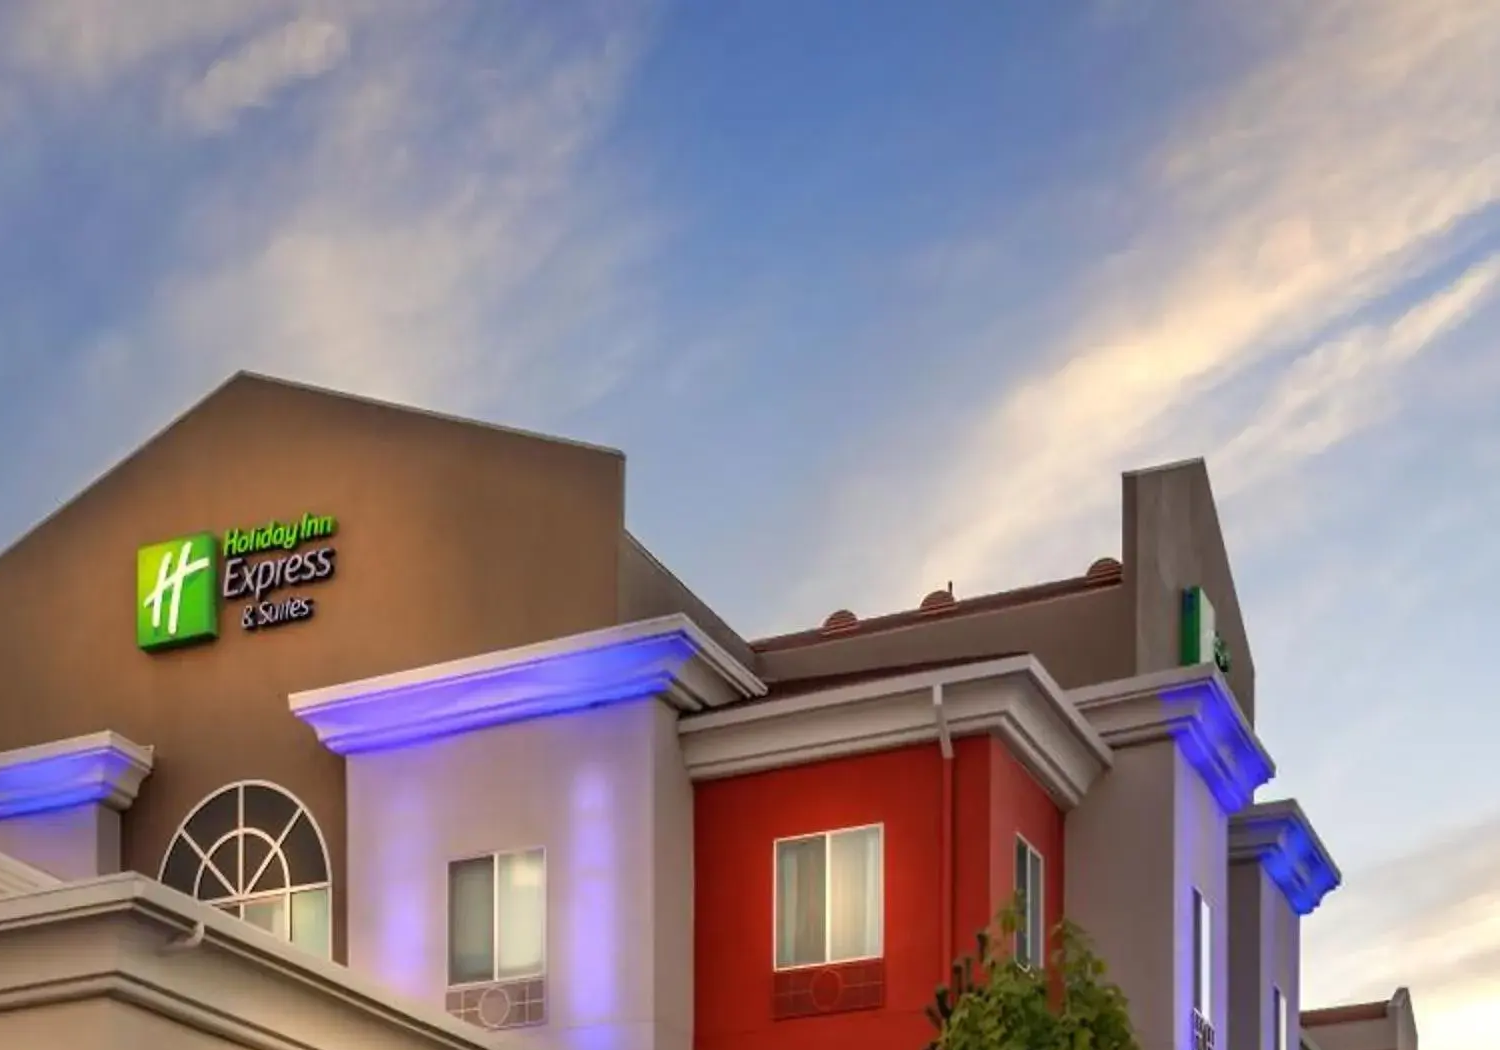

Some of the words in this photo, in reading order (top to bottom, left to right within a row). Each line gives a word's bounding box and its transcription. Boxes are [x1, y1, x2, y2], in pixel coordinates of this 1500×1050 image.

[223, 521, 300, 557] Holiday
[300, 512, 334, 539] Inn
[223, 547, 333, 599] Express
[241, 604, 254, 629] &
[258, 598, 310, 625] Suites
